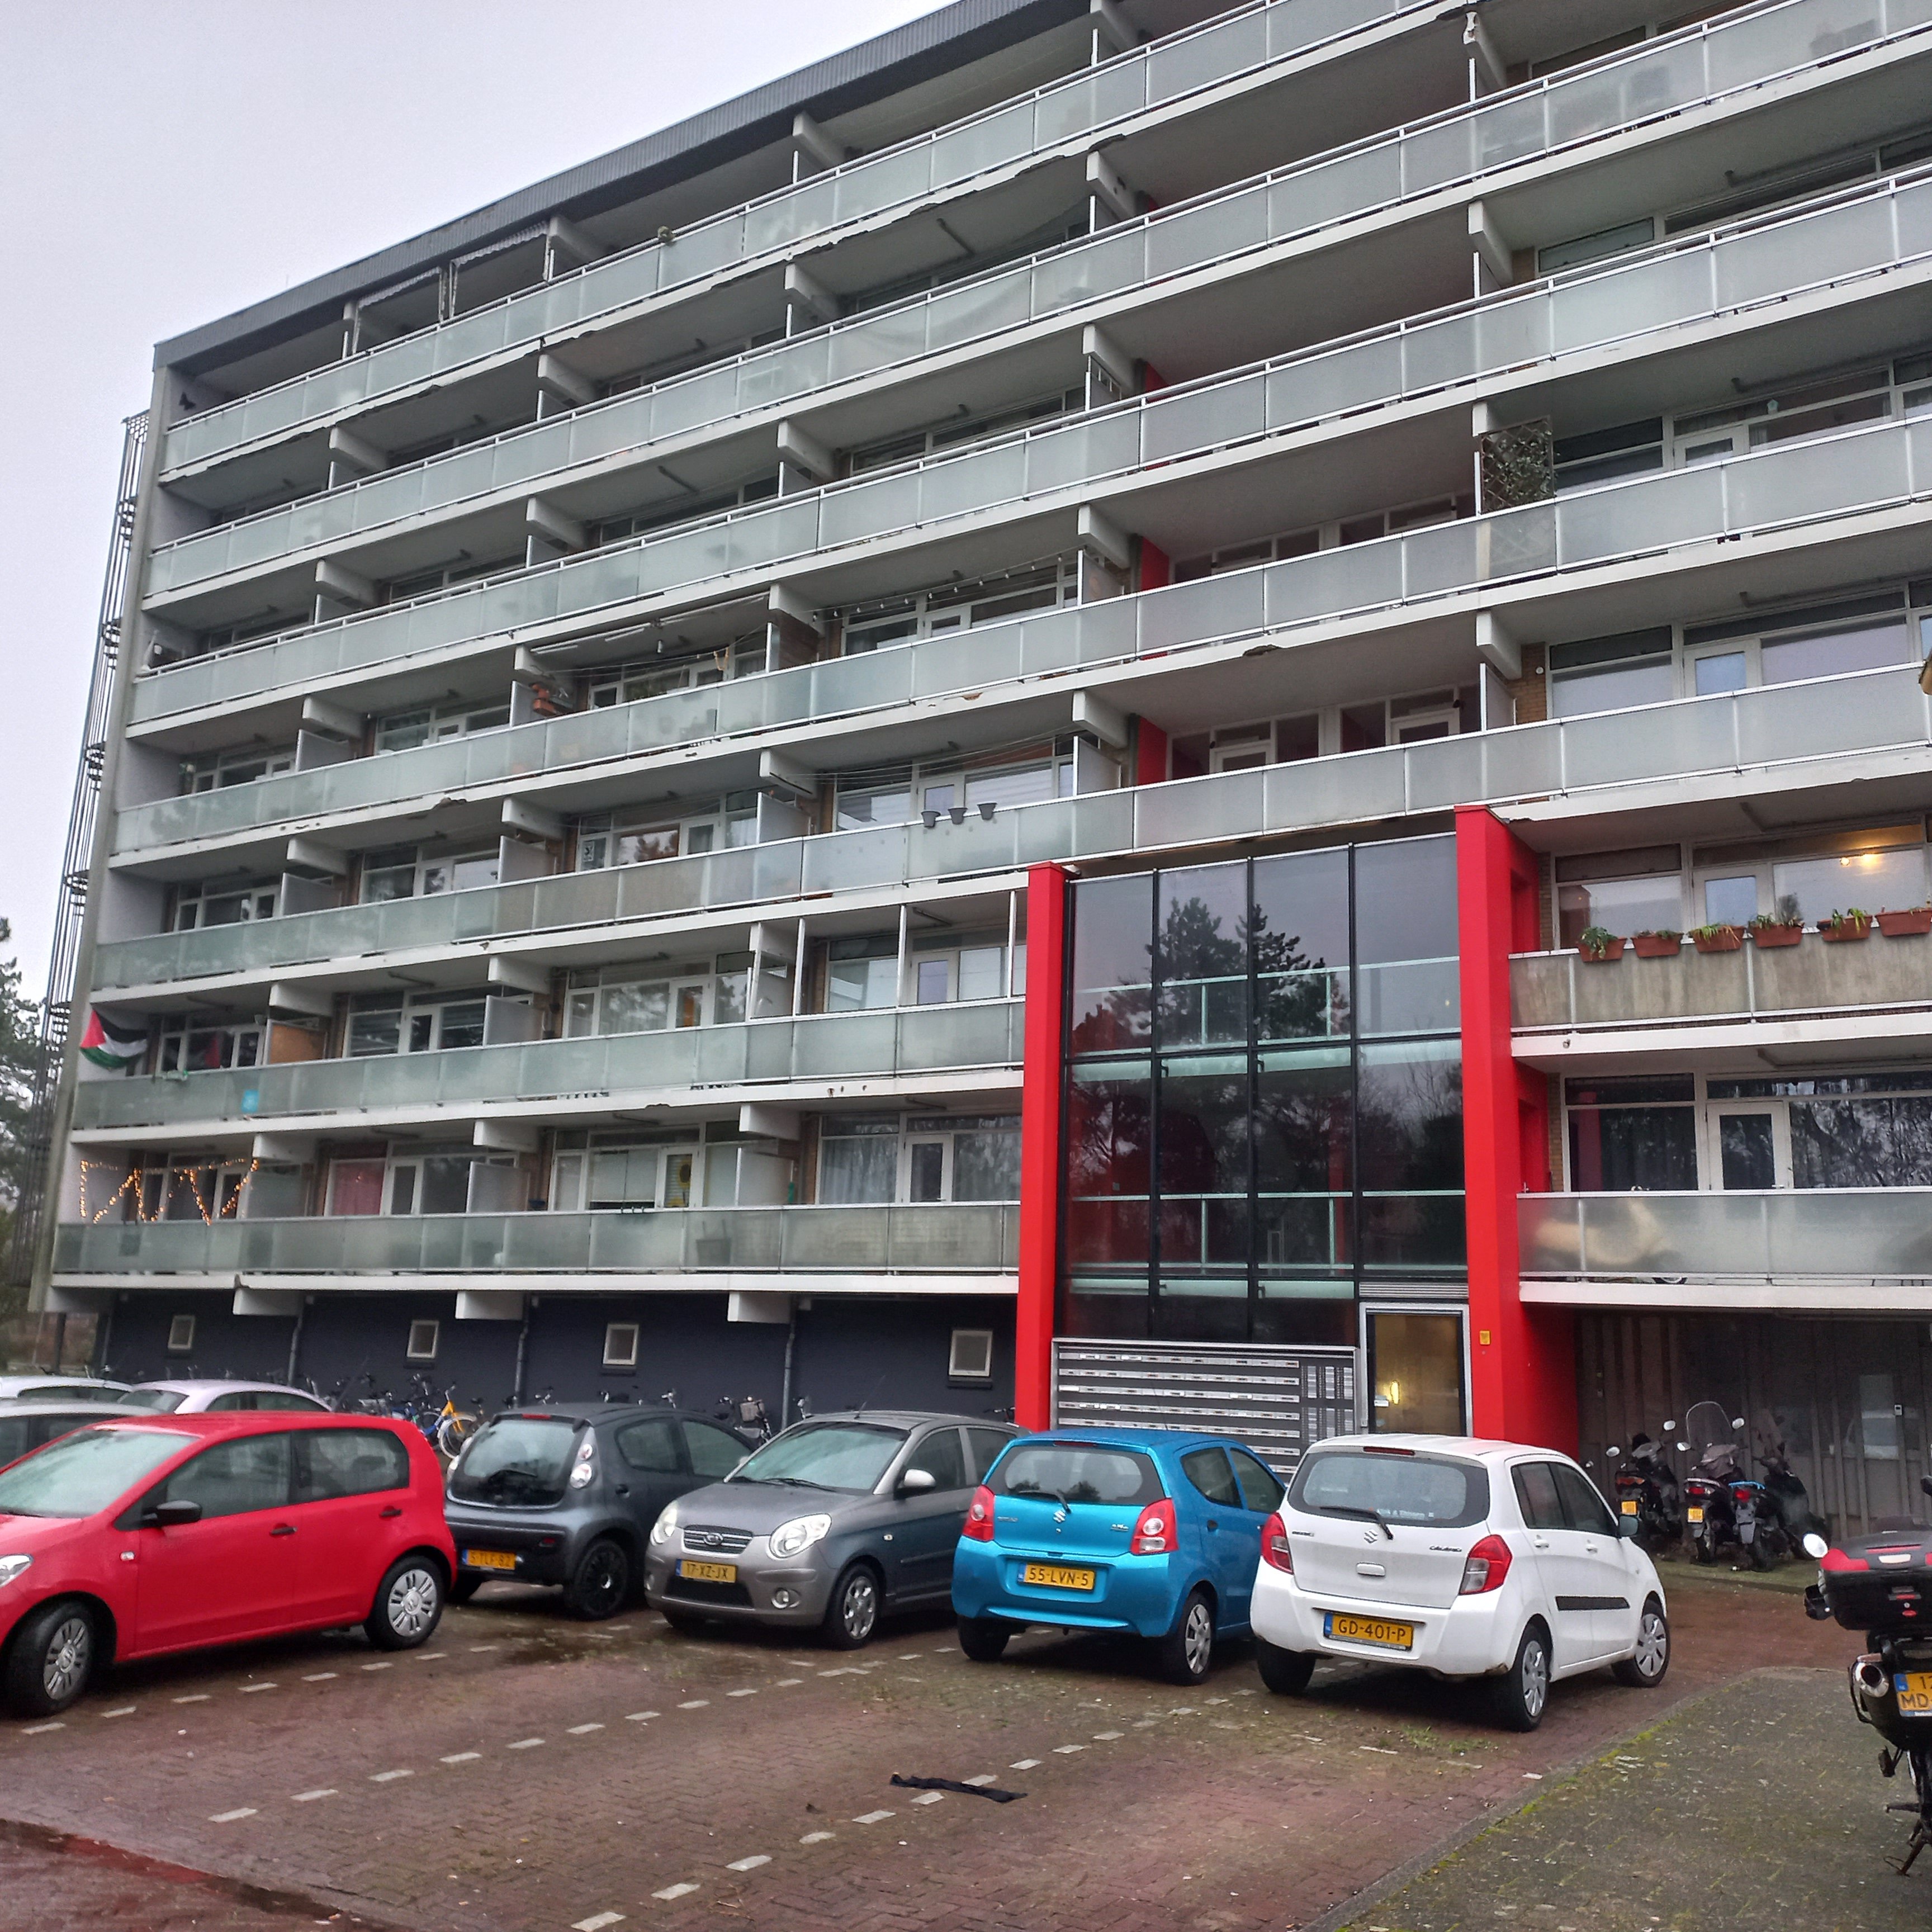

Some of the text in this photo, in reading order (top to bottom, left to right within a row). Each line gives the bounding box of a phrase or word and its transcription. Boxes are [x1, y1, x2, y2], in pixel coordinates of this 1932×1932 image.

[686, 1563, 728, 1579] 17-XZ-JX
[1029, 1567, 1088, 1587] 55-LVN-5
[1338, 1619, 1406, 1642] GD-401-P
